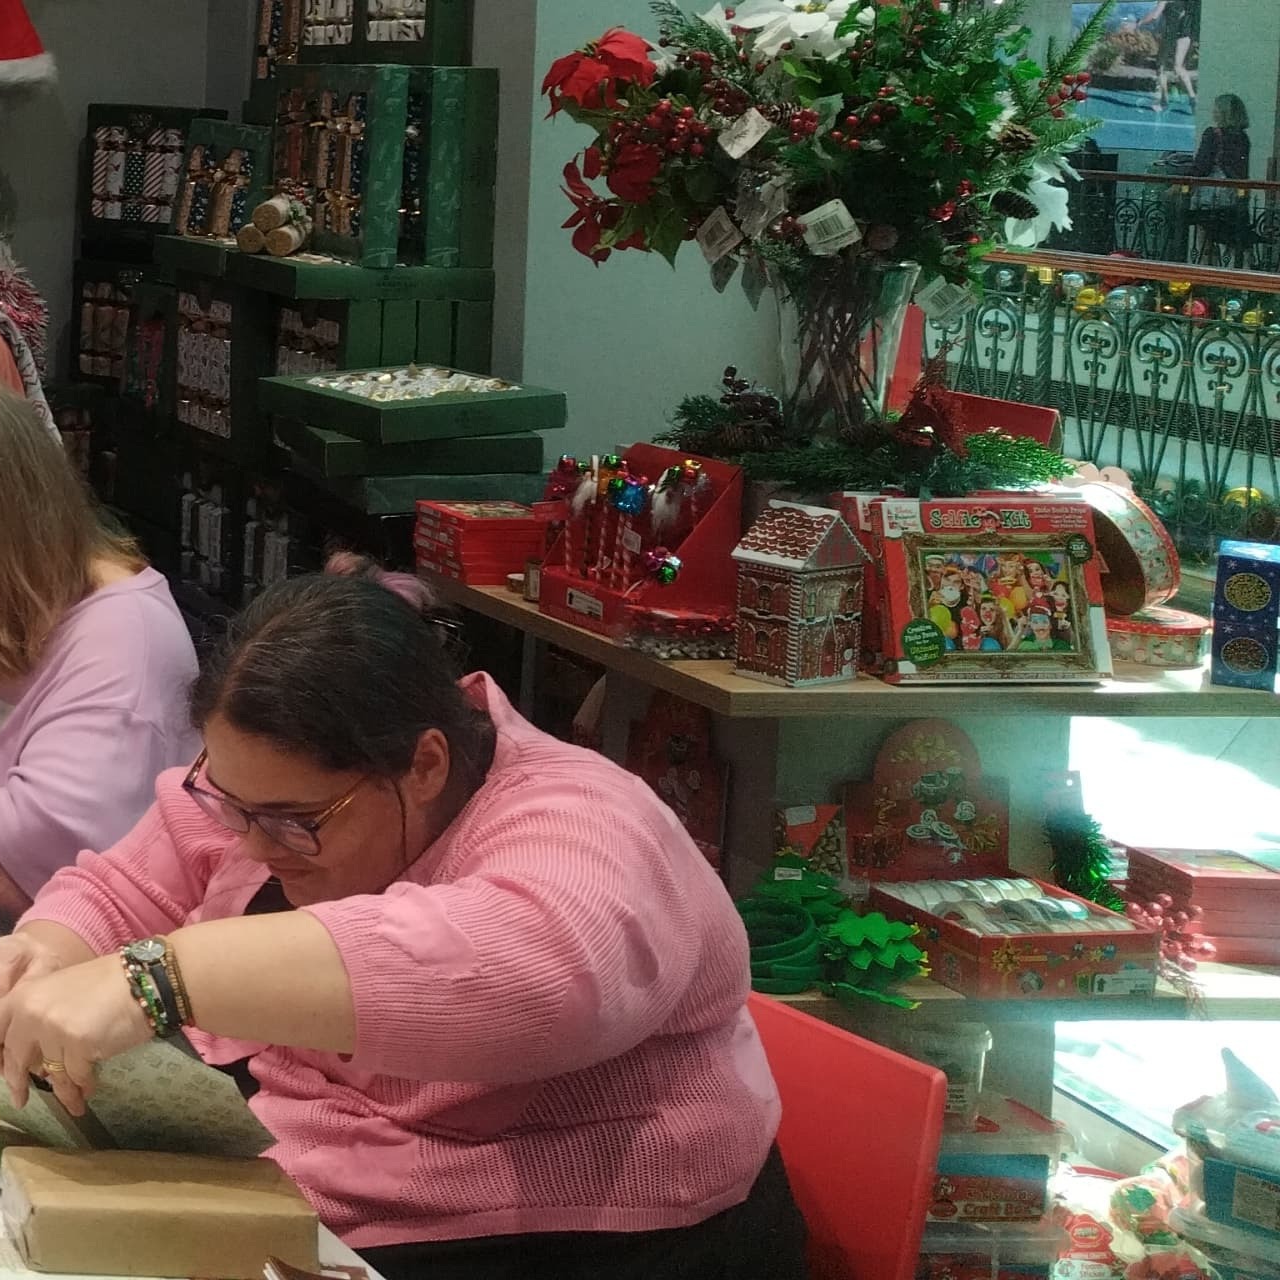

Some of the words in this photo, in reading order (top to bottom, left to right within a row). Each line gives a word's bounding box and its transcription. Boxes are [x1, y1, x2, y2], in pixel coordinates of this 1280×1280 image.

[929, 508, 982, 529] Selfie
[1000, 510, 1032, 529] Kit
[963, 1203, 1001, 1215] Craft
